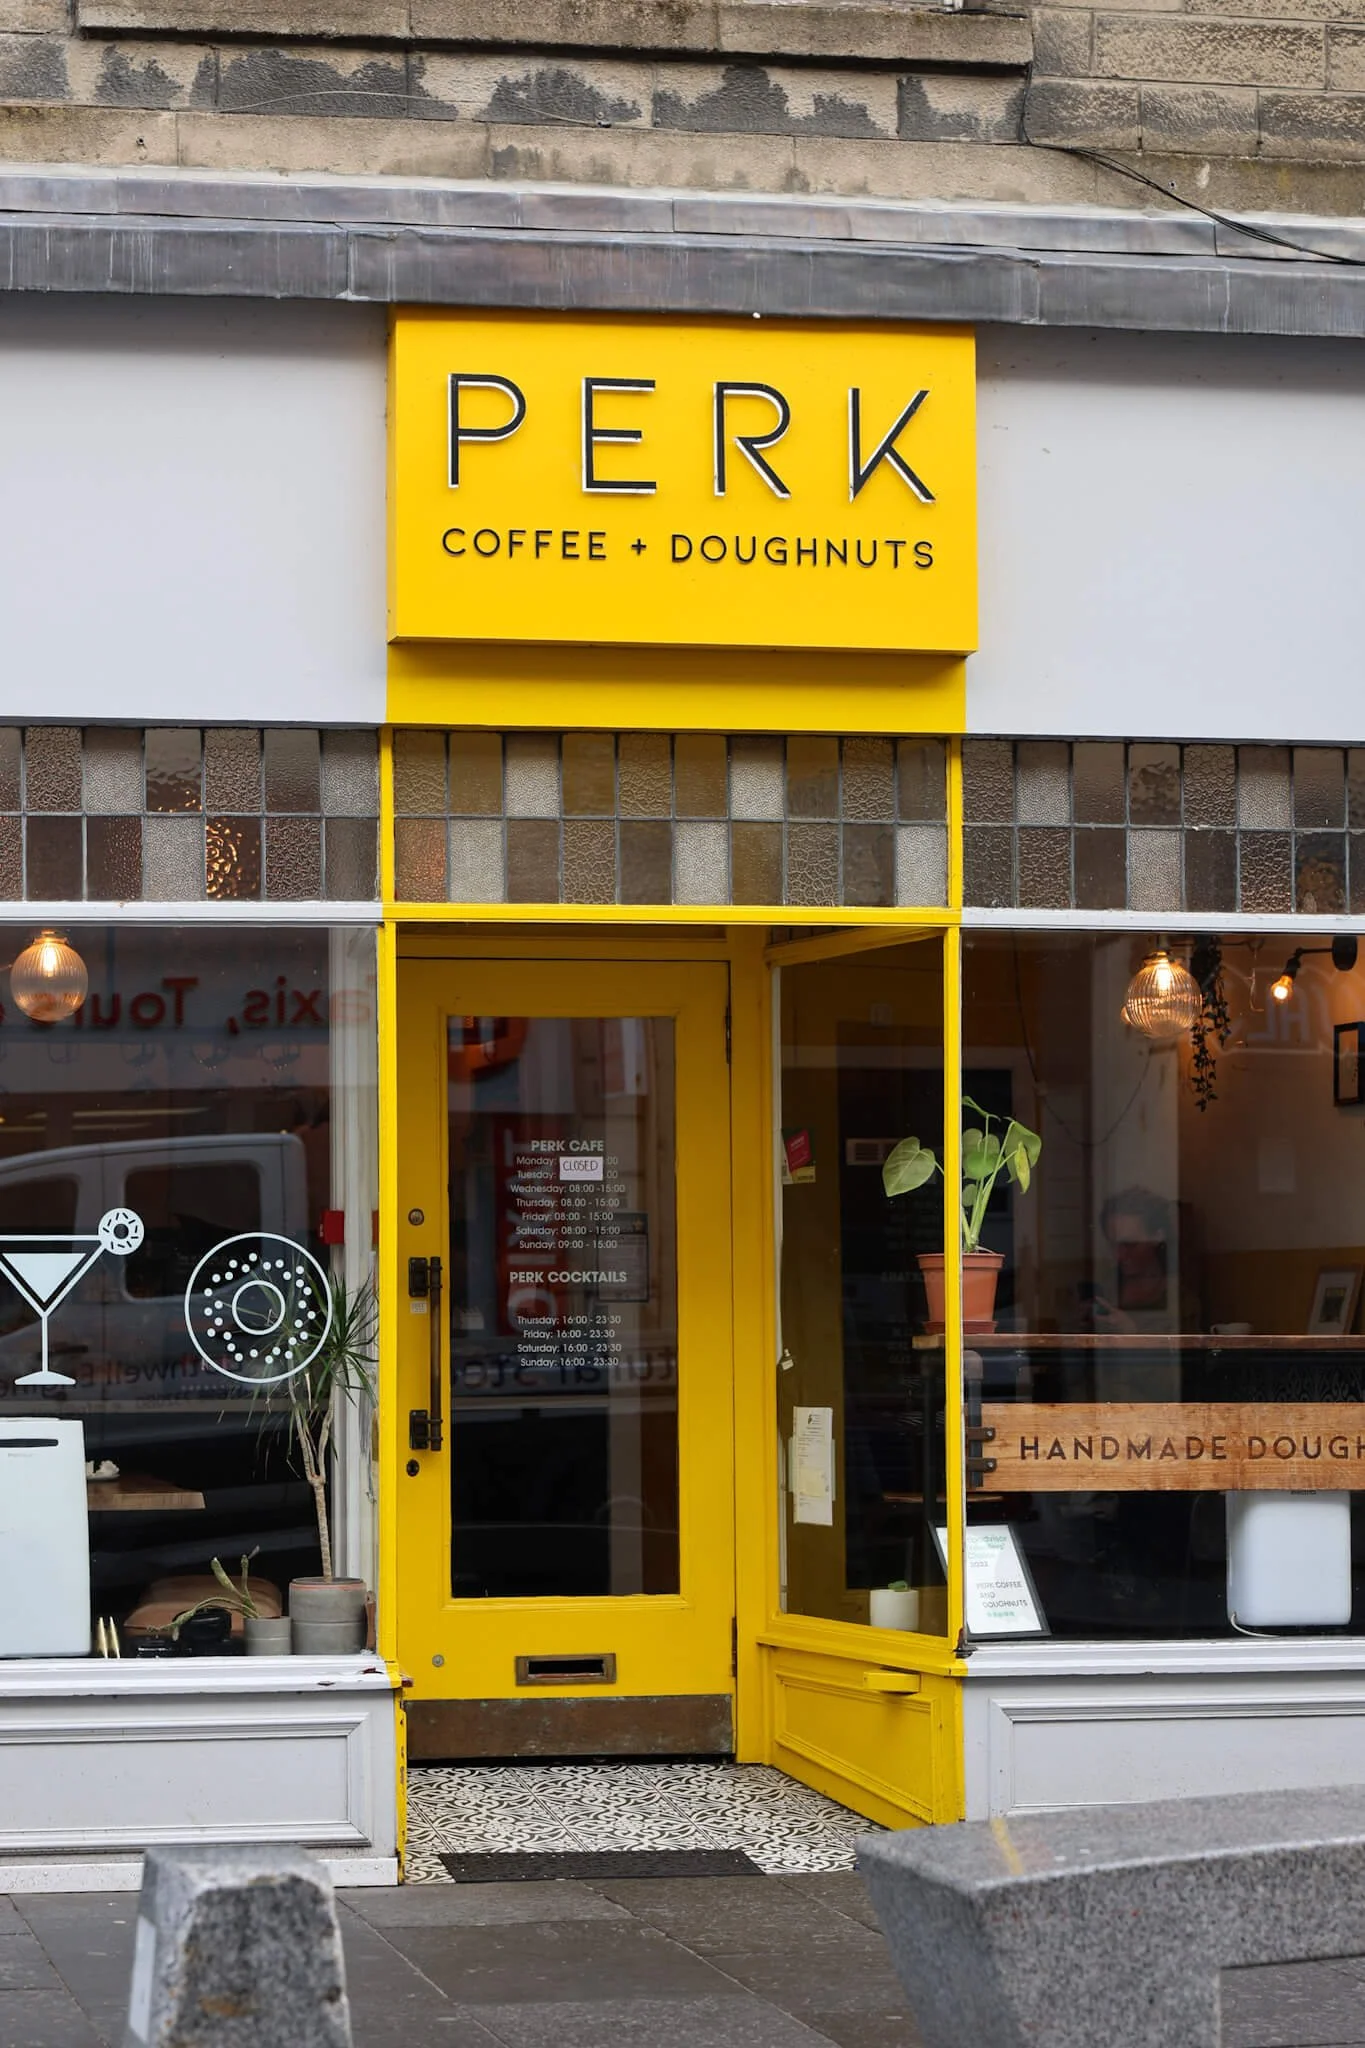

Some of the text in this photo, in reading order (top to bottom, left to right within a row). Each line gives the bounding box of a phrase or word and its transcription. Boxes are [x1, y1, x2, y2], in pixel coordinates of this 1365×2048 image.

[446, 372, 936, 503] PERK
[442, 527, 607, 560] COFFEE
[671, 533, 934, 569] DOUGHNUTS
[531, 1140, 604, 1152] PERK CAFE
[516, 1156, 557, 1167] Monday:
[562, 1160, 599, 1172] CLOSED
[517, 1171, 557, 1180] Tuesday:
[510, 1184, 566, 1194] Wednesday:
[516, 1198, 558, 1208] Thursday:
[522, 1212, 552, 1222] Friday:
[516, 1226, 559, 1236] Saturday:
[520, 1240, 555, 1250] Sunday:
[510, 1271, 627, 1283] PERK COCKTAILS
[517, 1315, 559, 1325] Thursday:
[523, 1330, 553, 1340] Friday:
[557, 1330, 581, 1338] 16:00
[590, 1330, 615, 1338] 23:30
[517, 1344, 560, 1354] Saturday:
[521, 1358, 557, 1368] Sunday:
[560, 1358, 585, 1366] 16:00
[593, 1358, 619, 1366] 23:30
[1020, 1436, 1228, 1460] HANDMADE
[995, 1581, 1023, 1589] COFFEE
[982, 1599, 1028, 1608] DOUGHNUTS
